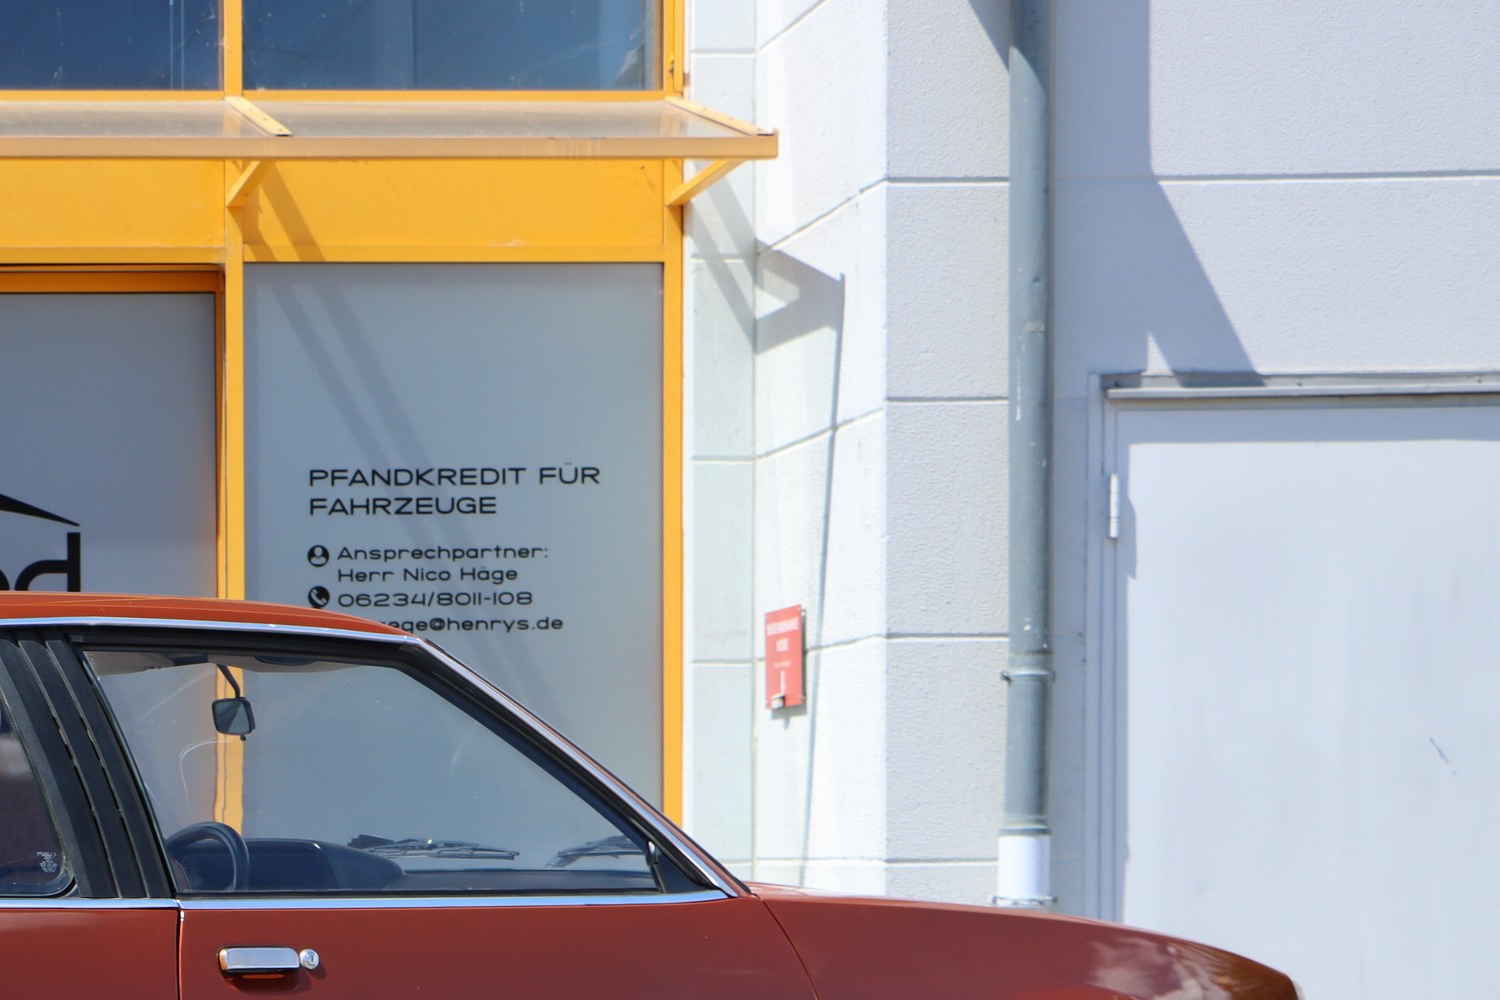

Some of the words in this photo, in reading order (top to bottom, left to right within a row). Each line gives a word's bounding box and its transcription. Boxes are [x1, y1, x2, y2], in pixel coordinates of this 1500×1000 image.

[308, 466, 527, 487] PFANDKREDIT
[538, 462, 601, 485] FÜR
[309, 496, 497, 516] FAHRZEUGE
[336, 544, 549, 562] Ansprechpartner:
[337, 567, 395, 583] Herr
[403, 567, 452, 582] Nico
[459, 566, 519, 586] Häge
[337, 590, 533, 608] 06234/8011-108
